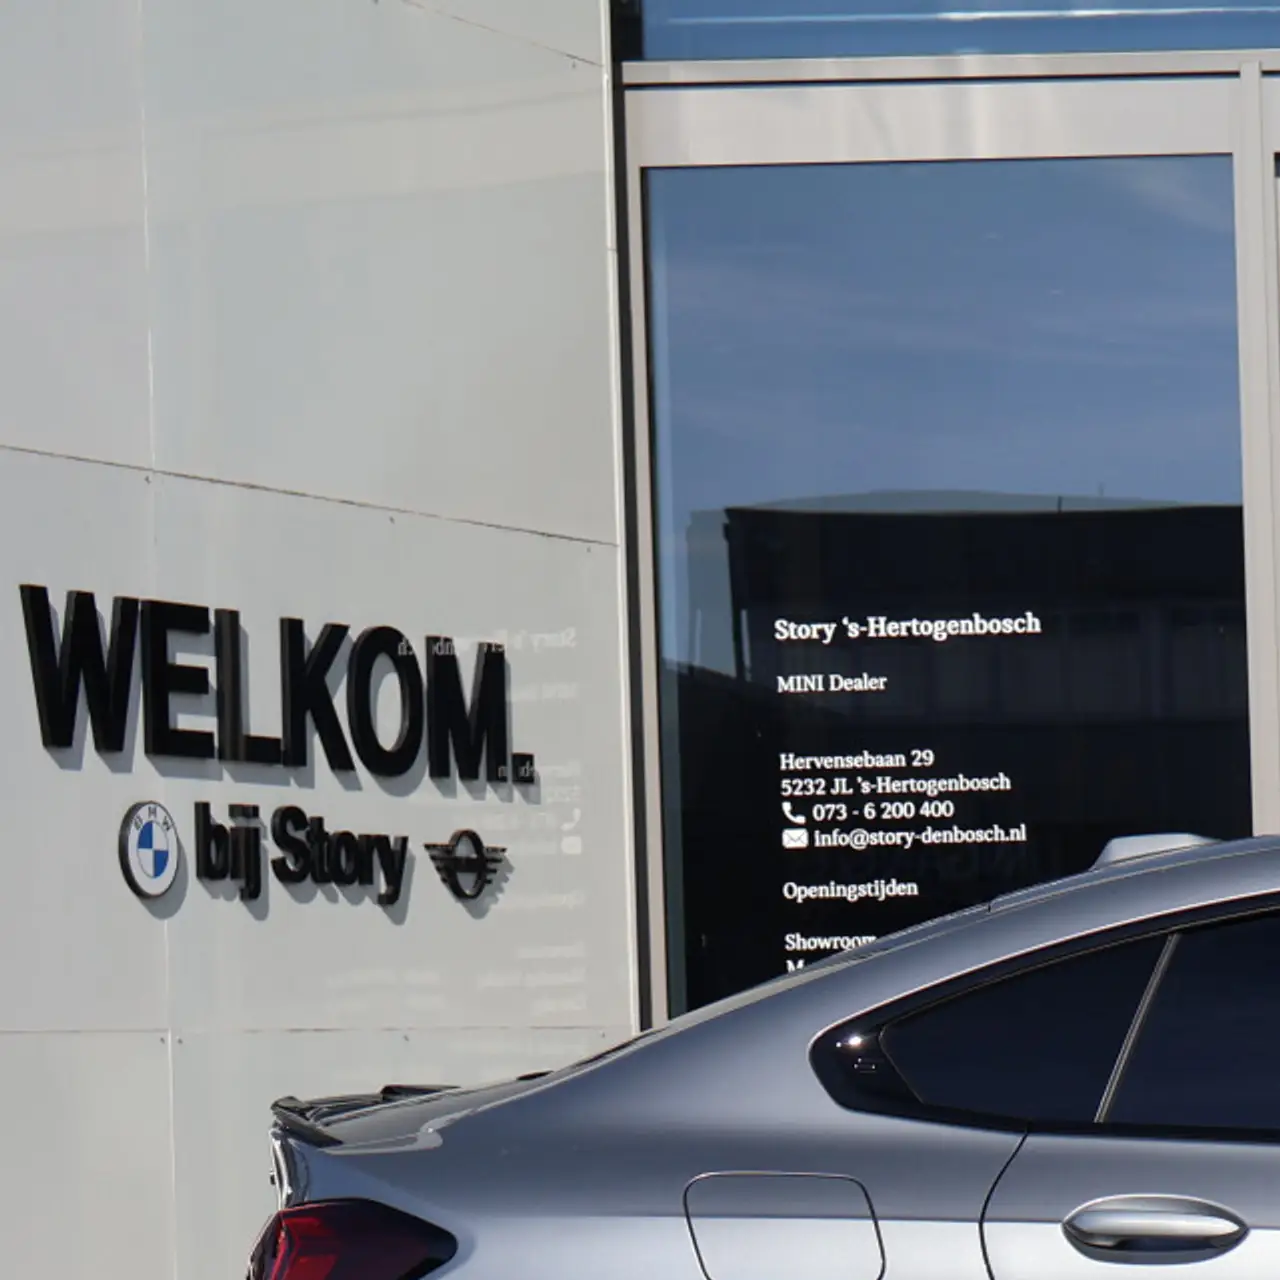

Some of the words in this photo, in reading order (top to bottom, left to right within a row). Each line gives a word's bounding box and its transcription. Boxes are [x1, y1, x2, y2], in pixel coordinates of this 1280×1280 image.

[775, 619, 837, 644] Story
[842, 612, 1042, 641] 's-Hertogenbosch
[19, 584, 535, 784] WELKOM.
[777, 674, 825, 693] MINI
[829, 672, 887, 692] Dealer
[780, 750, 906, 770] Hervensebaan
[911, 749, 935, 767] 29
[781, 778, 826, 796] 5232
[830, 776, 853, 796] JL
[857, 772, 1012, 796] 's-Hertogenbosch
[813, 803, 848, 821] 073
[864, 802, 876, 819] 6
[881, 801, 915, 819] 200
[920, 800, 955, 818] 400
[814, 823, 1027, 850] info@story-denbosch.nl
[194, 801, 261, 900] bij
[271, 805, 408, 905] Story
[783, 879, 918, 903] Openingstijden
